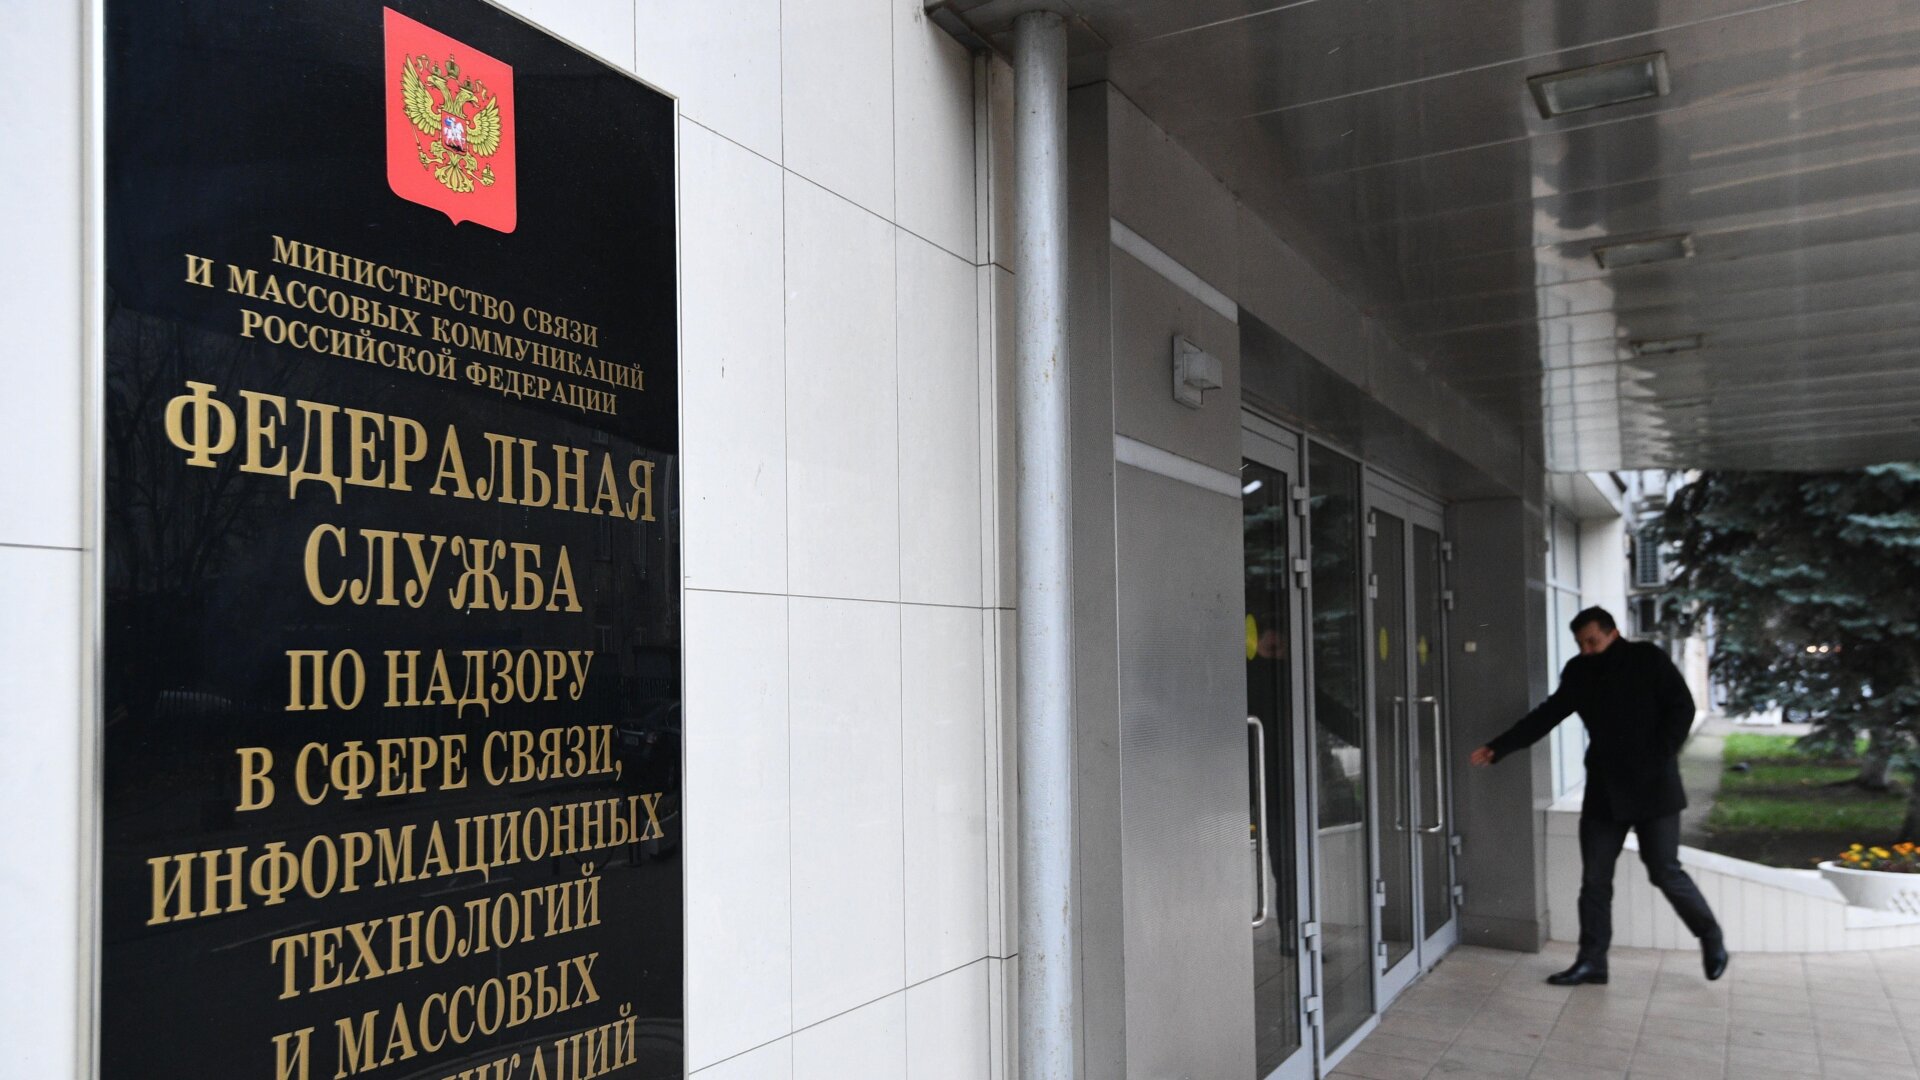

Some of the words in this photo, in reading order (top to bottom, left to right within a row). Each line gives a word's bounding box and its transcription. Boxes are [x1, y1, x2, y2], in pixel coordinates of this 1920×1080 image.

[184, 253, 215, 288] И
[227, 264, 422, 337] МАССОВЫХ
[431, 316, 644, 391] КОММУНИКАЦИЙ
[271, 234, 516, 325] МИНИСТЕРСТВО
[523, 307, 598, 348] СВЯЗИ
[240, 308, 457, 381] РОССИЙСКОЙ
[465, 360, 617, 415] ФЕДЕРАЦИИ
[164, 380, 656, 522] ФЕДЕРАЛЬНАЯ
[303, 523, 583, 613] СЛУЖБА
[285, 648, 366, 711] ПО
[383, 648, 594, 719] НАДЗОРУ
[235, 746, 275, 812] В
[295, 734, 468, 806] СФЕРЕ
[482, 724, 622, 786] СВЯЗИ,
[146, 792, 665, 926] ИНФОРМАЦИОННЫХ
[271, 861, 602, 1000] ТЕХНОЛОГИЙ
[271, 1026, 315, 1080] И
[333, 951, 601, 1080] МАССОВЫХ
